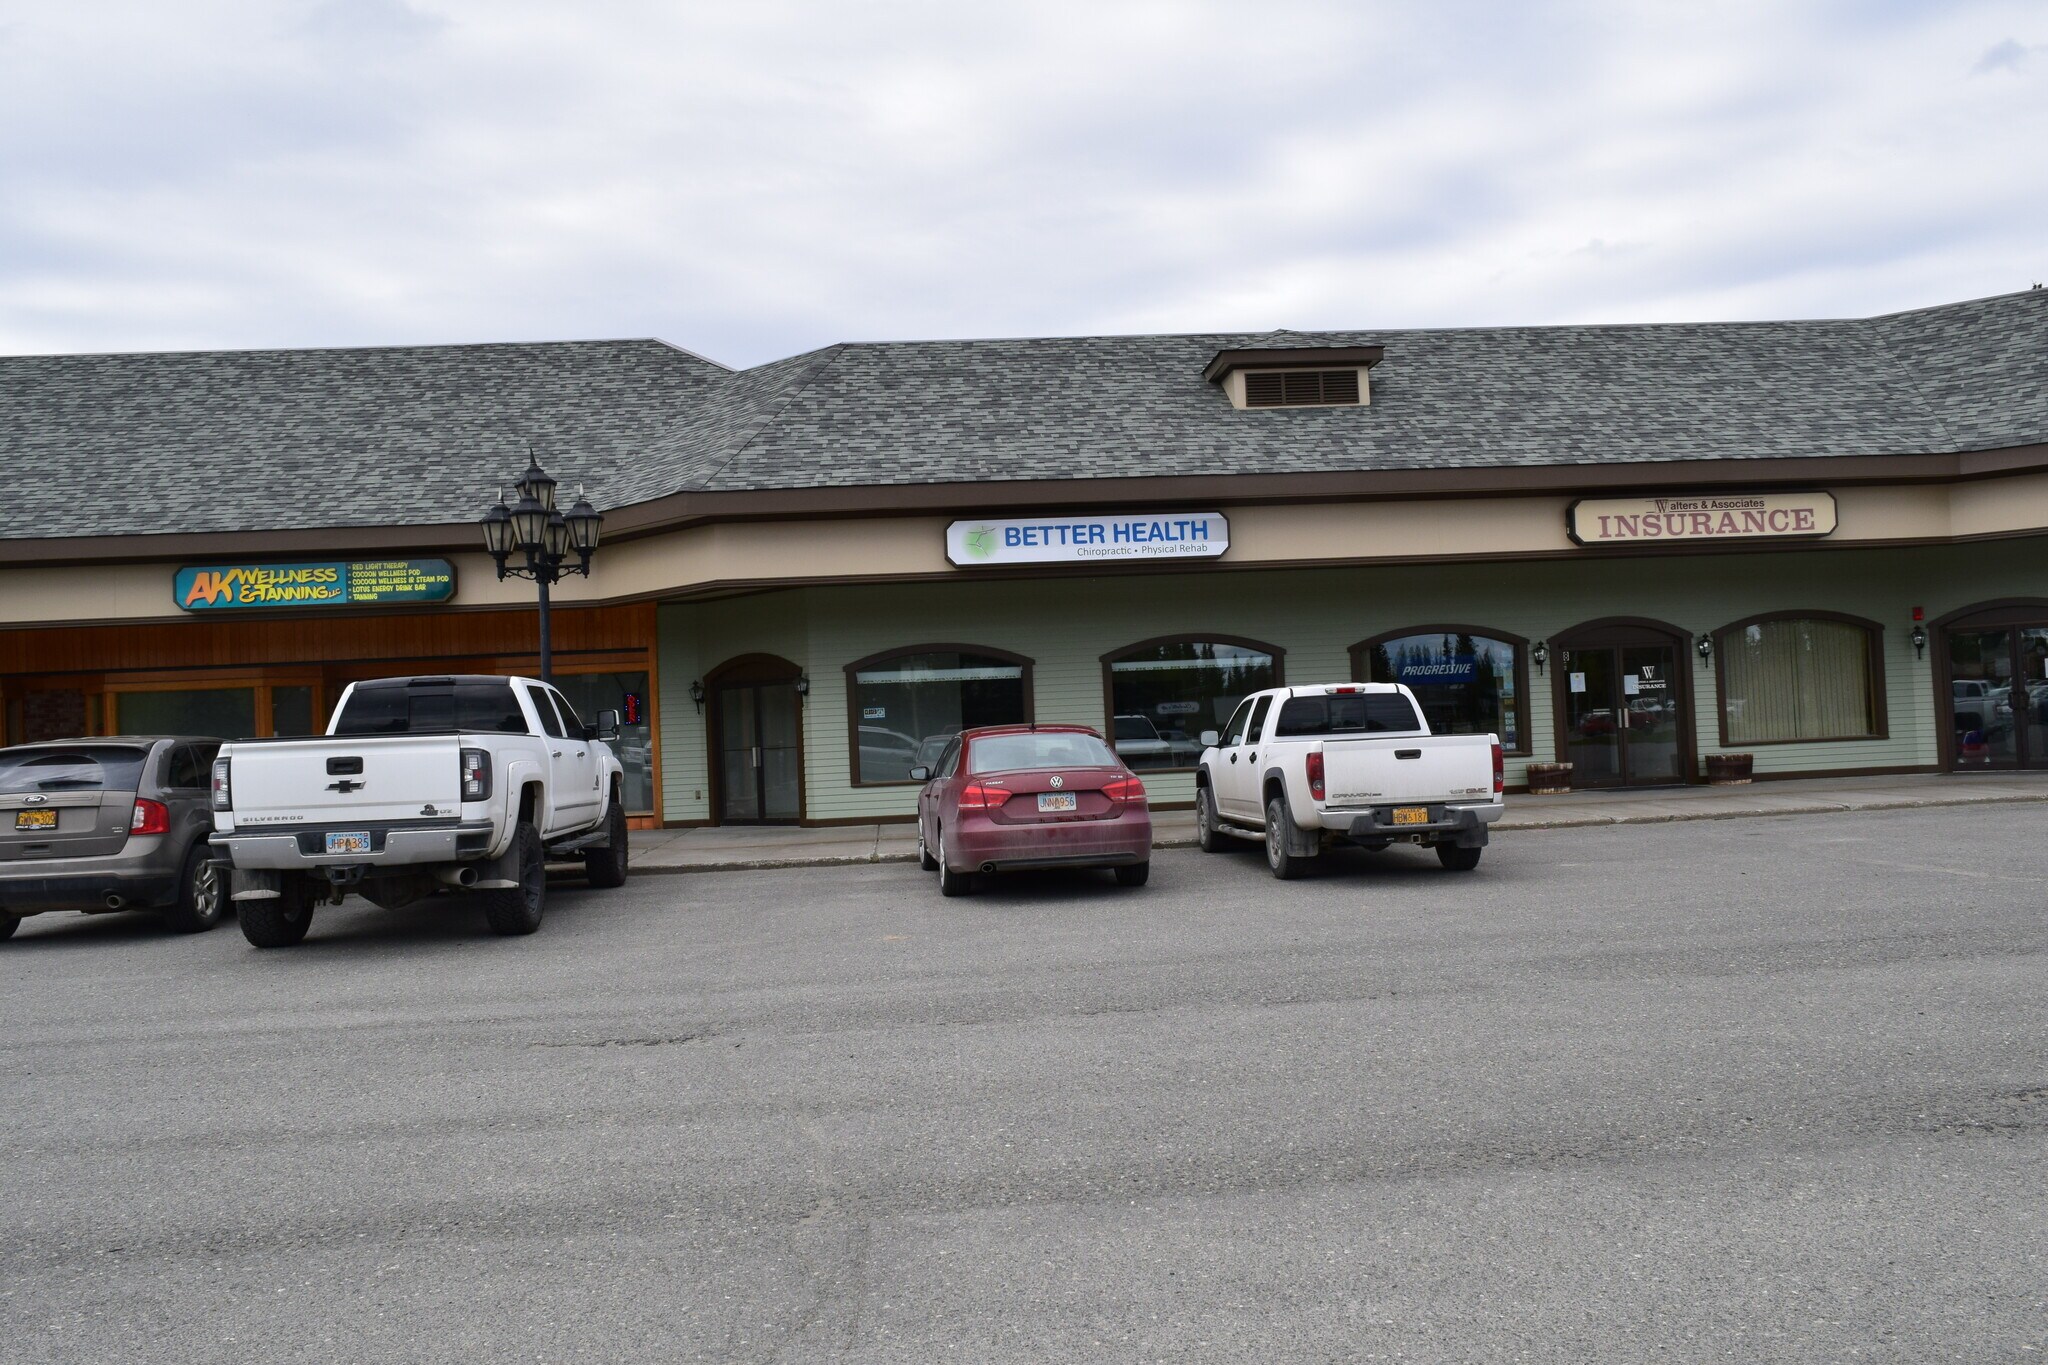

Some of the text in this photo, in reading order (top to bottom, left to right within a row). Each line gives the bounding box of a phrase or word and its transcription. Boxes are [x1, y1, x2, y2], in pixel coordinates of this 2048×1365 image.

[1701, 501, 1708, 509] &
[1711, 499, 1765, 509] Associates
[1598, 508, 1815, 538] INSURANCE
[1005, 520, 1208, 547] BETTER HEALTH
[1077, 544, 1208, 557] Chiropractic Physical Rehab
[235, 567, 338, 584] WELLNESS
[185, 569, 238, 606] AK
[256, 584, 328, 602] TANNING
[1402, 664, 1472, 676] PROGRESSIVE
[1642, 666, 1655, 679] W
